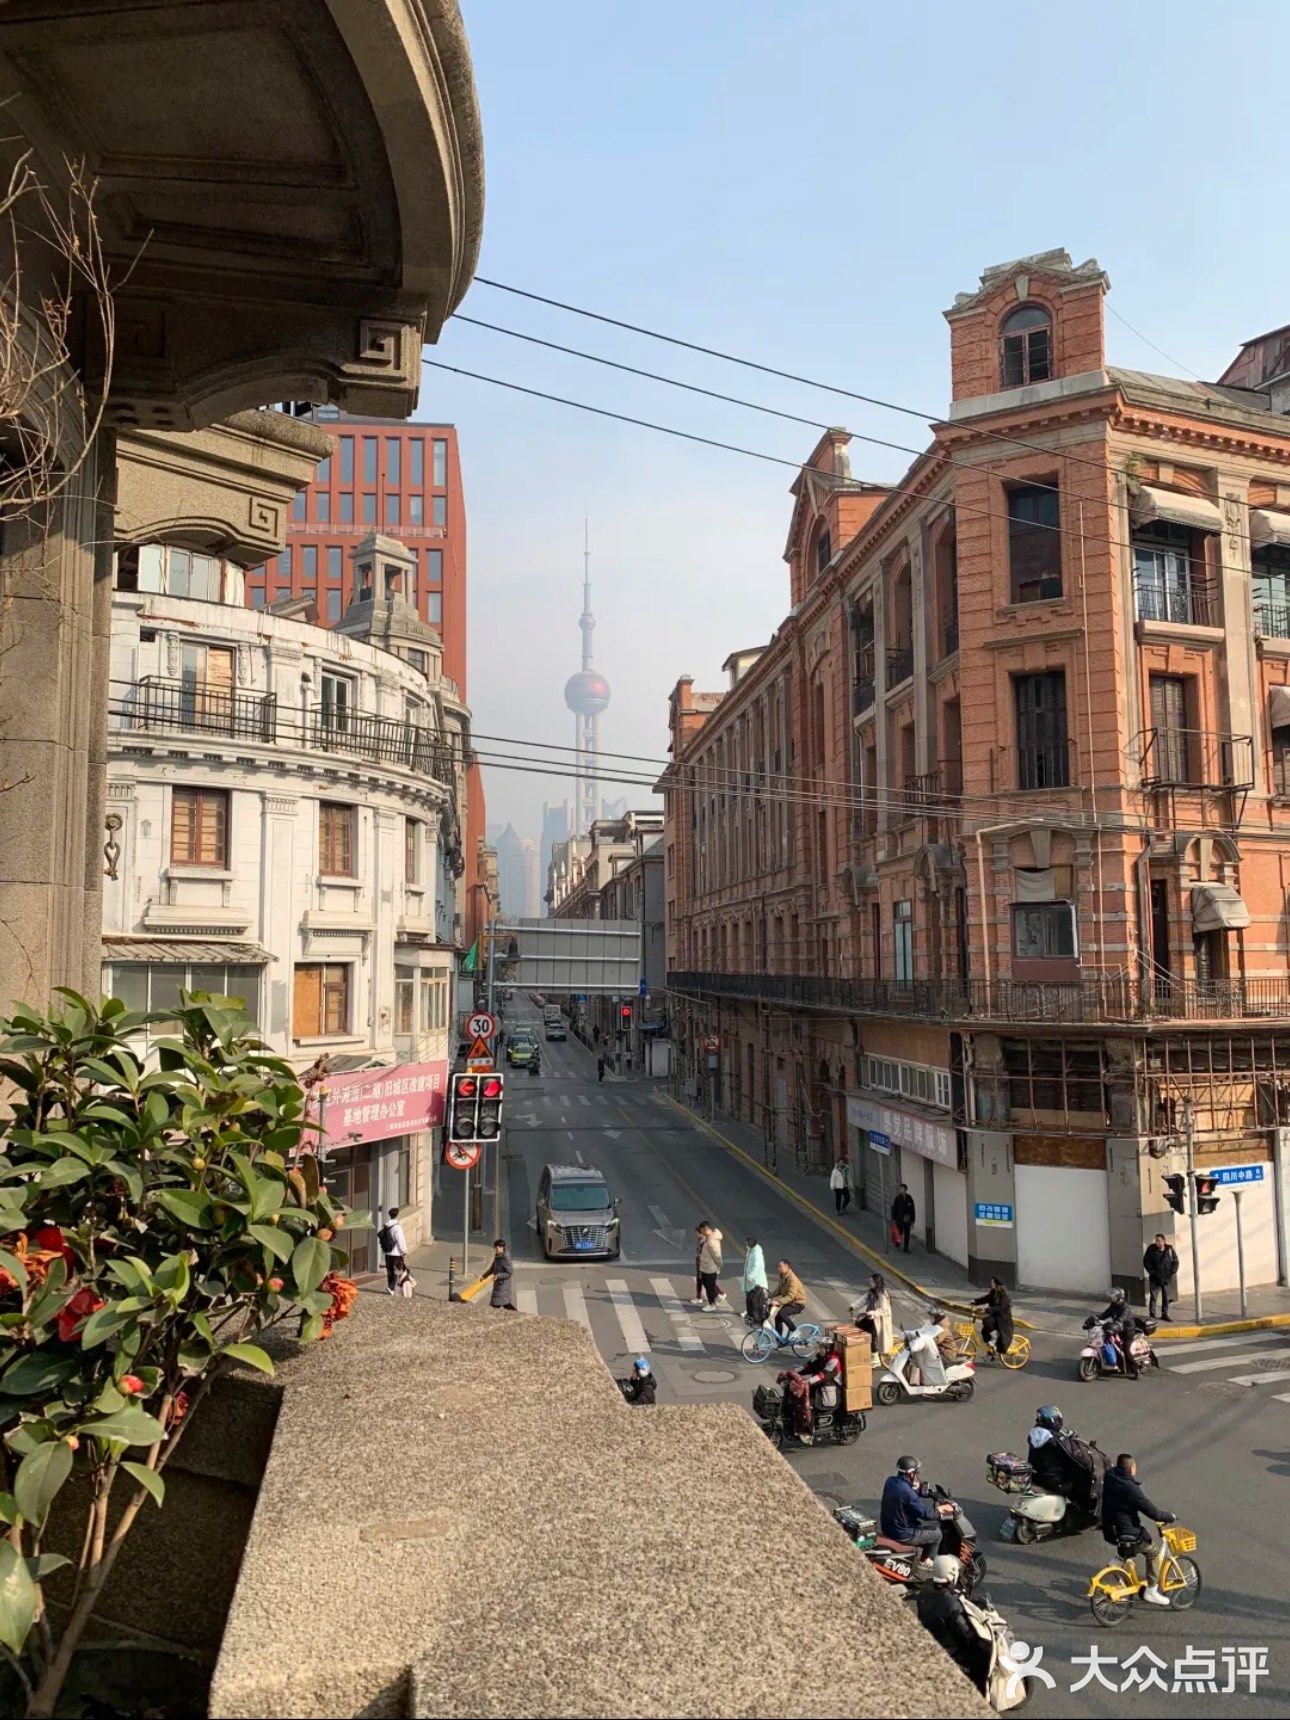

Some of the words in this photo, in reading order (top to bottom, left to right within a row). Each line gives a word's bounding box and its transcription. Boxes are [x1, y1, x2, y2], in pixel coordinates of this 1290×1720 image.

[473, 1019, 489, 1033] 30
[1222, 1169, 1253, 1182] 四川中路
[883, 1558, 911, 1577] EV80
